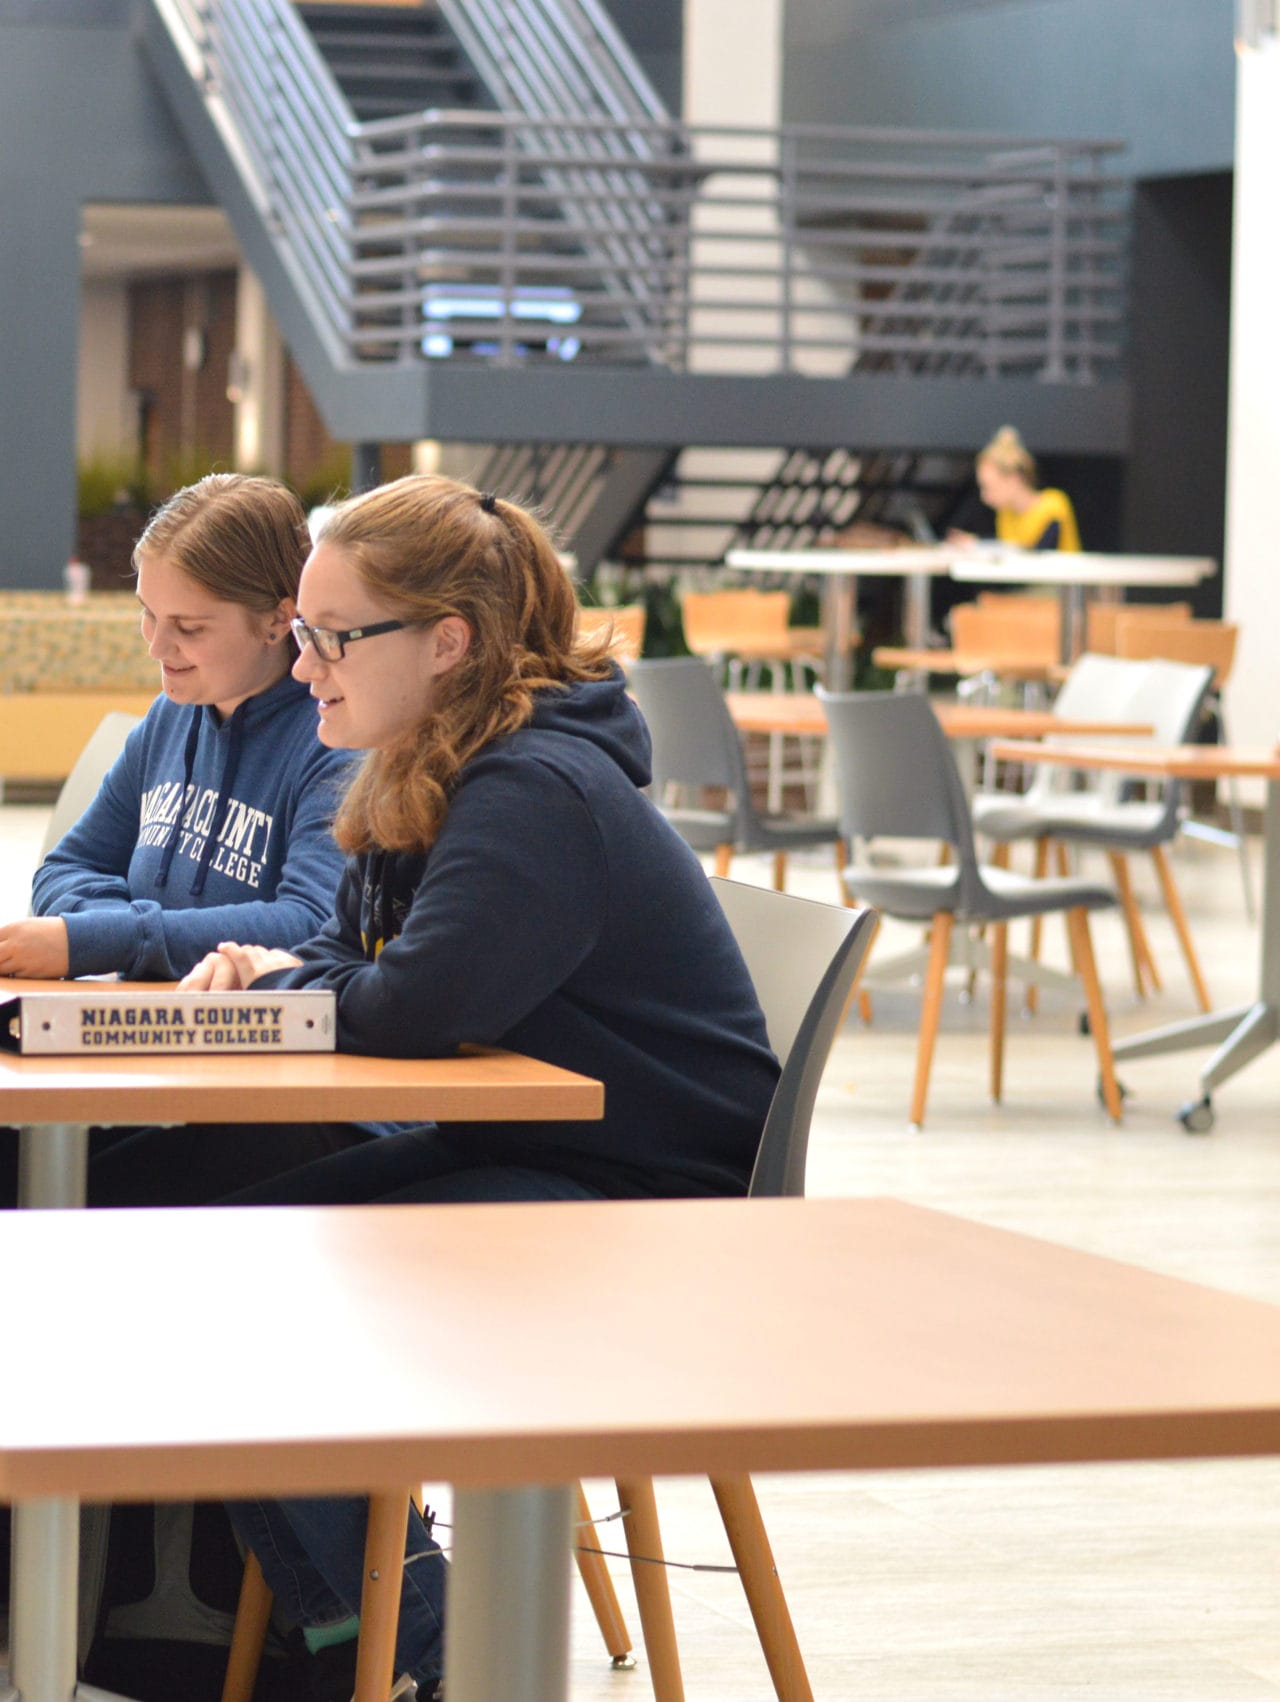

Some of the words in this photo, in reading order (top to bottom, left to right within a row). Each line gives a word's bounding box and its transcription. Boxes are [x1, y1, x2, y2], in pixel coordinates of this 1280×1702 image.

[81, 1007, 185, 1026] NIAGARA
[193, 1007, 282, 1025] COUNTY
[81, 1029, 196, 1045] COMMUNITY
[203, 1028, 282, 1044] COLLEGE
